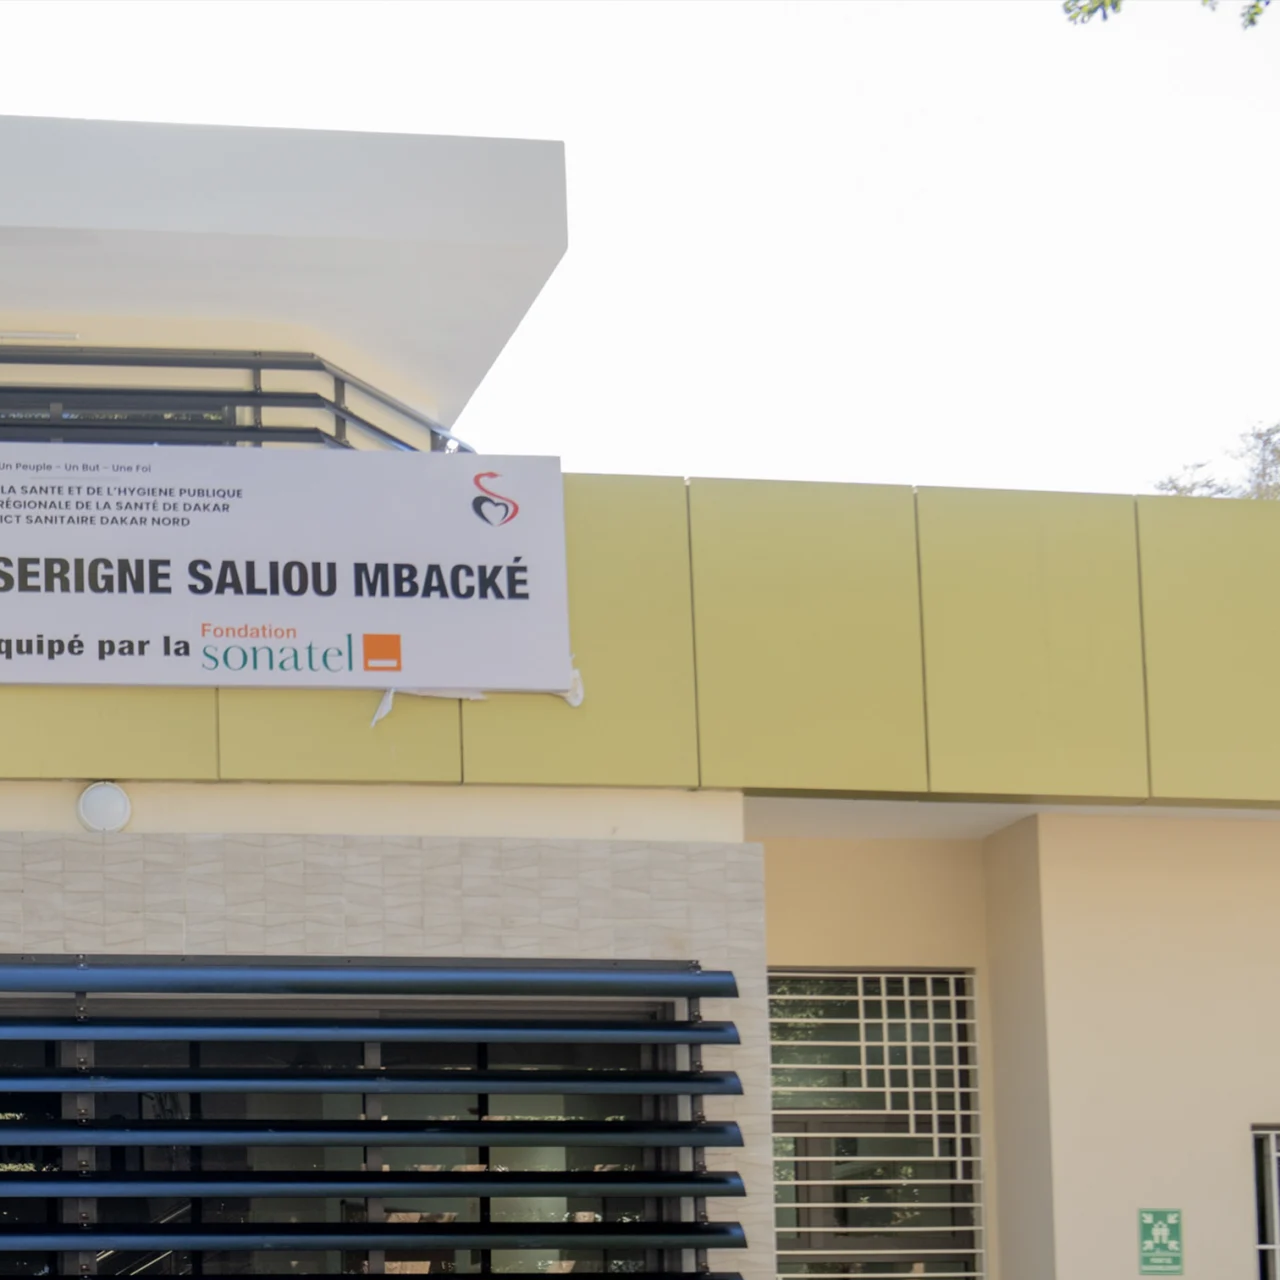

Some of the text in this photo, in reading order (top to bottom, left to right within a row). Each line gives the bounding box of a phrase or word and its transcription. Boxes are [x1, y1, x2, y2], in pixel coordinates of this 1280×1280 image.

[15, 462, 53, 473] Peuple
[64, 463, 79, 472] Un
[82, 463, 100, 472] But
[112, 464, 133, 473] Une
[136, 464, 151, 473] Foi
[1, 485, 16, 495] LA
[20, 485, 64, 495] SANTE
[68, 486, 83, 495] ET
[86, 486, 103, 496] DE
[179, 488, 243, 499] PUBLIQUE
[75, 501, 92, 511] DE
[96, 501, 112, 511] LA
[116, 499, 159, 512] SANTÉ
[163, 502, 179, 512] DE
[183, 502, 230, 513] DAKAR
[25, 514, 97, 526] SANITAIRE
[100, 516, 147, 526] DAKAR
[151, 516, 191, 527] NORD
[187, 558, 337, 597] SALIOU
[353, 556, 530, 600] MBACKÉ
[201, 622, 298, 640] Fondation
[98, 637, 150, 661] par
[163, 635, 191, 657] la
[201, 633, 354, 673] sonatel
